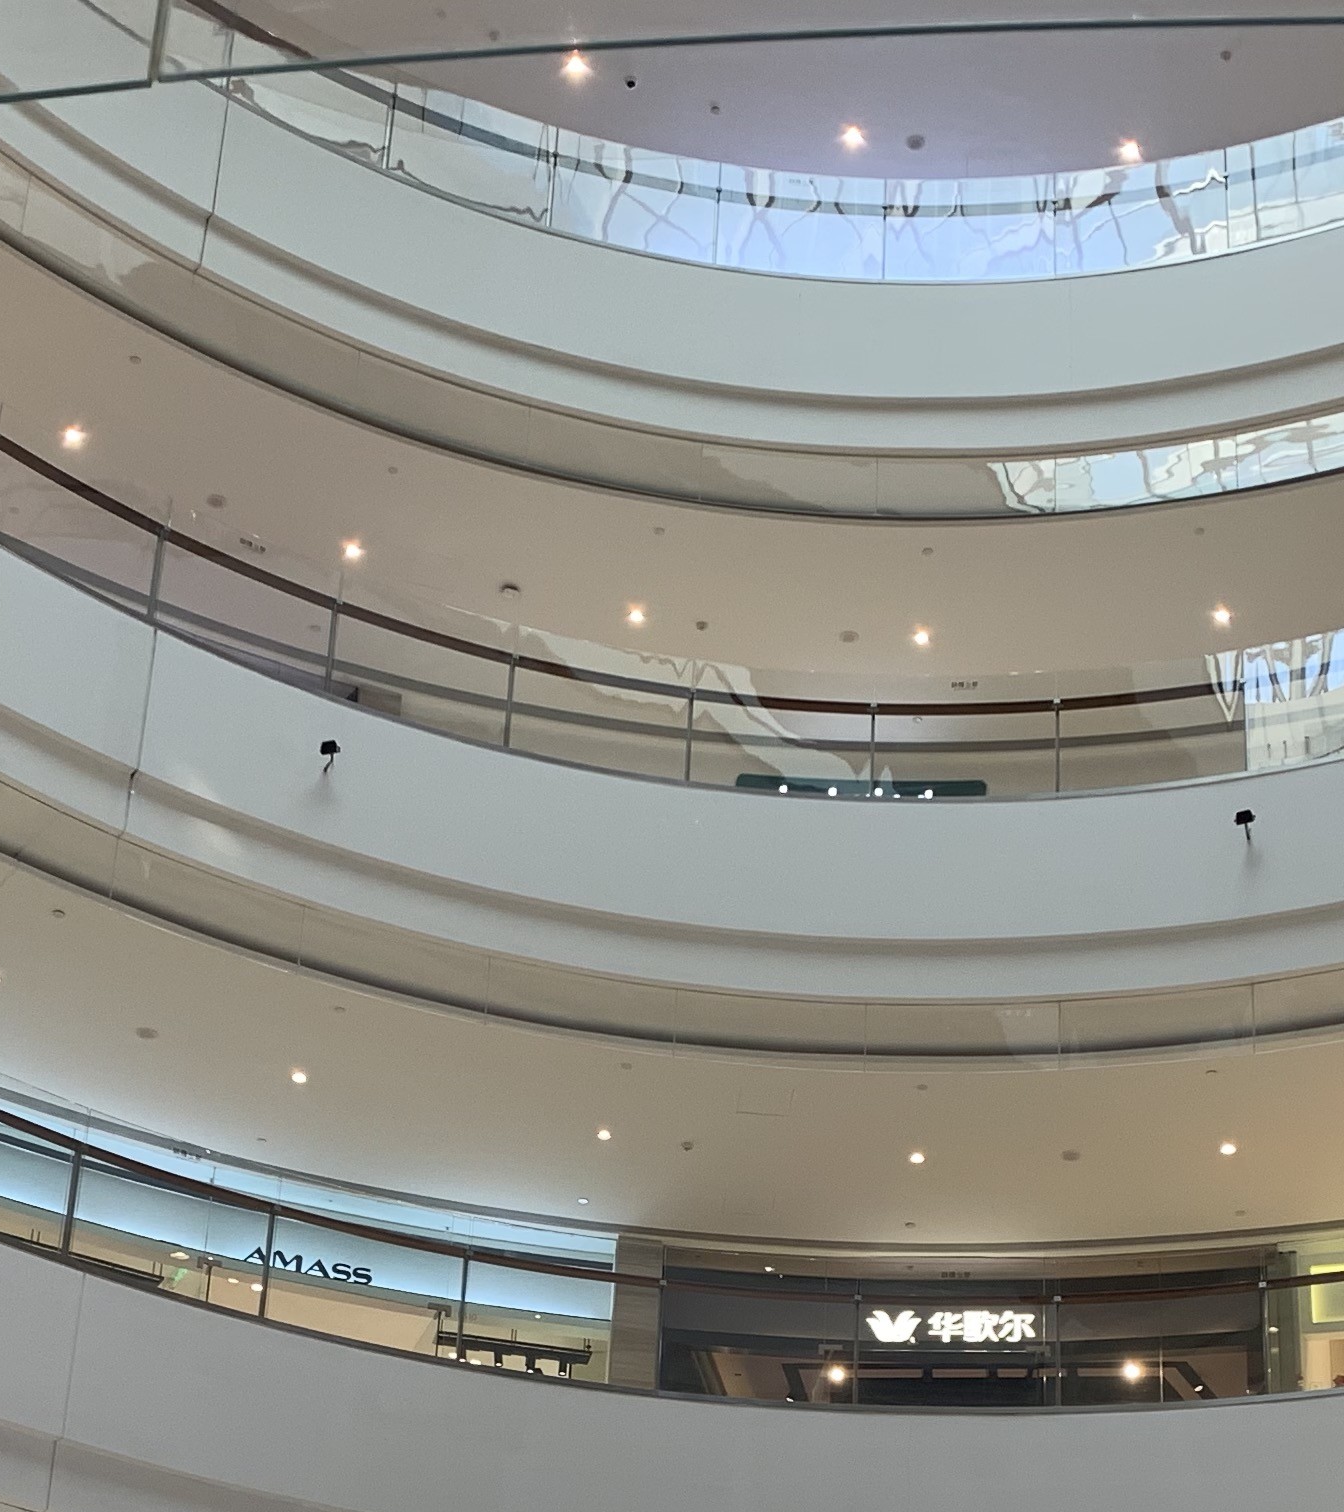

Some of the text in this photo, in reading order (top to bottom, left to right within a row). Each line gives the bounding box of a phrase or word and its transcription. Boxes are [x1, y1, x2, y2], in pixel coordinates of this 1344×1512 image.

[243, 1246, 373, 1286] AMASS
[927, 1310, 1036, 1344] 华歌尔
